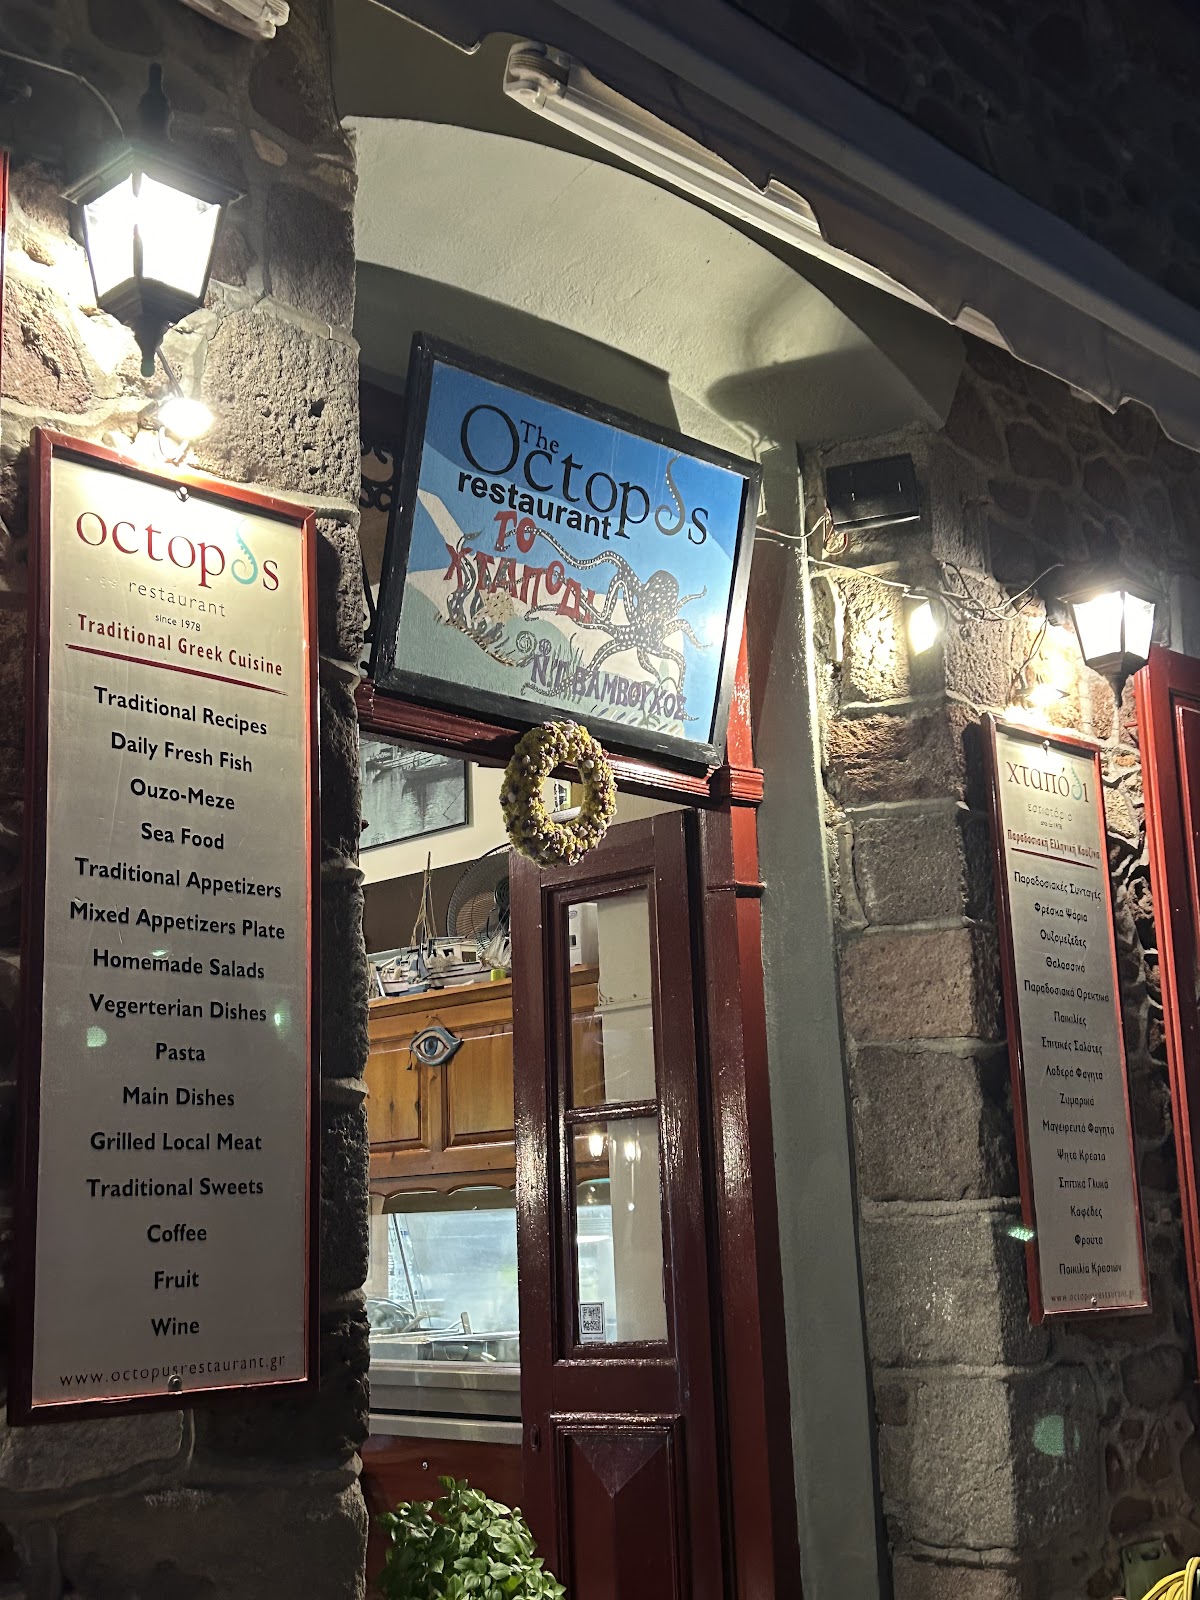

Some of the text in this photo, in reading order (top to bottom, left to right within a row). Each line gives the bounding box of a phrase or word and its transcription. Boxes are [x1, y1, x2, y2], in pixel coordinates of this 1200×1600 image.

[520, 419, 560, 454] The
[457, 471, 612, 541] restaurant
[128, 580, 226, 618] restaurant
[155, 614, 201, 632] since 1978
[78, 613, 283, 676] Traditional Greek Cuisine
[94, 685, 268, 735] Traditional Recipes
[111, 731, 253, 773] Daily Fresh Fish
[130, 778, 235, 810] Ouzo-Meze
[141, 822, 225, 850] Sea Food
[74, 857, 282, 898] Traditional Appetizers
[70, 901, 286, 940] Mixed Appetizers Plate
[93, 948, 265, 980] Homemade Salads
[89, 993, 267, 1021] Vegerterian Dishes
[156, 1042, 206, 1062] Pasta
[123, 1086, 235, 1106] Main Dishes
[90, 1131, 262, 1150] Grilled Local Meat
[86, 1177, 264, 1197] Traditional Sweets
[147, 1223, 207, 1243] Coffee
[153, 1269, 200, 1290] Fruit
[151, 1317, 200, 1337] Wine
